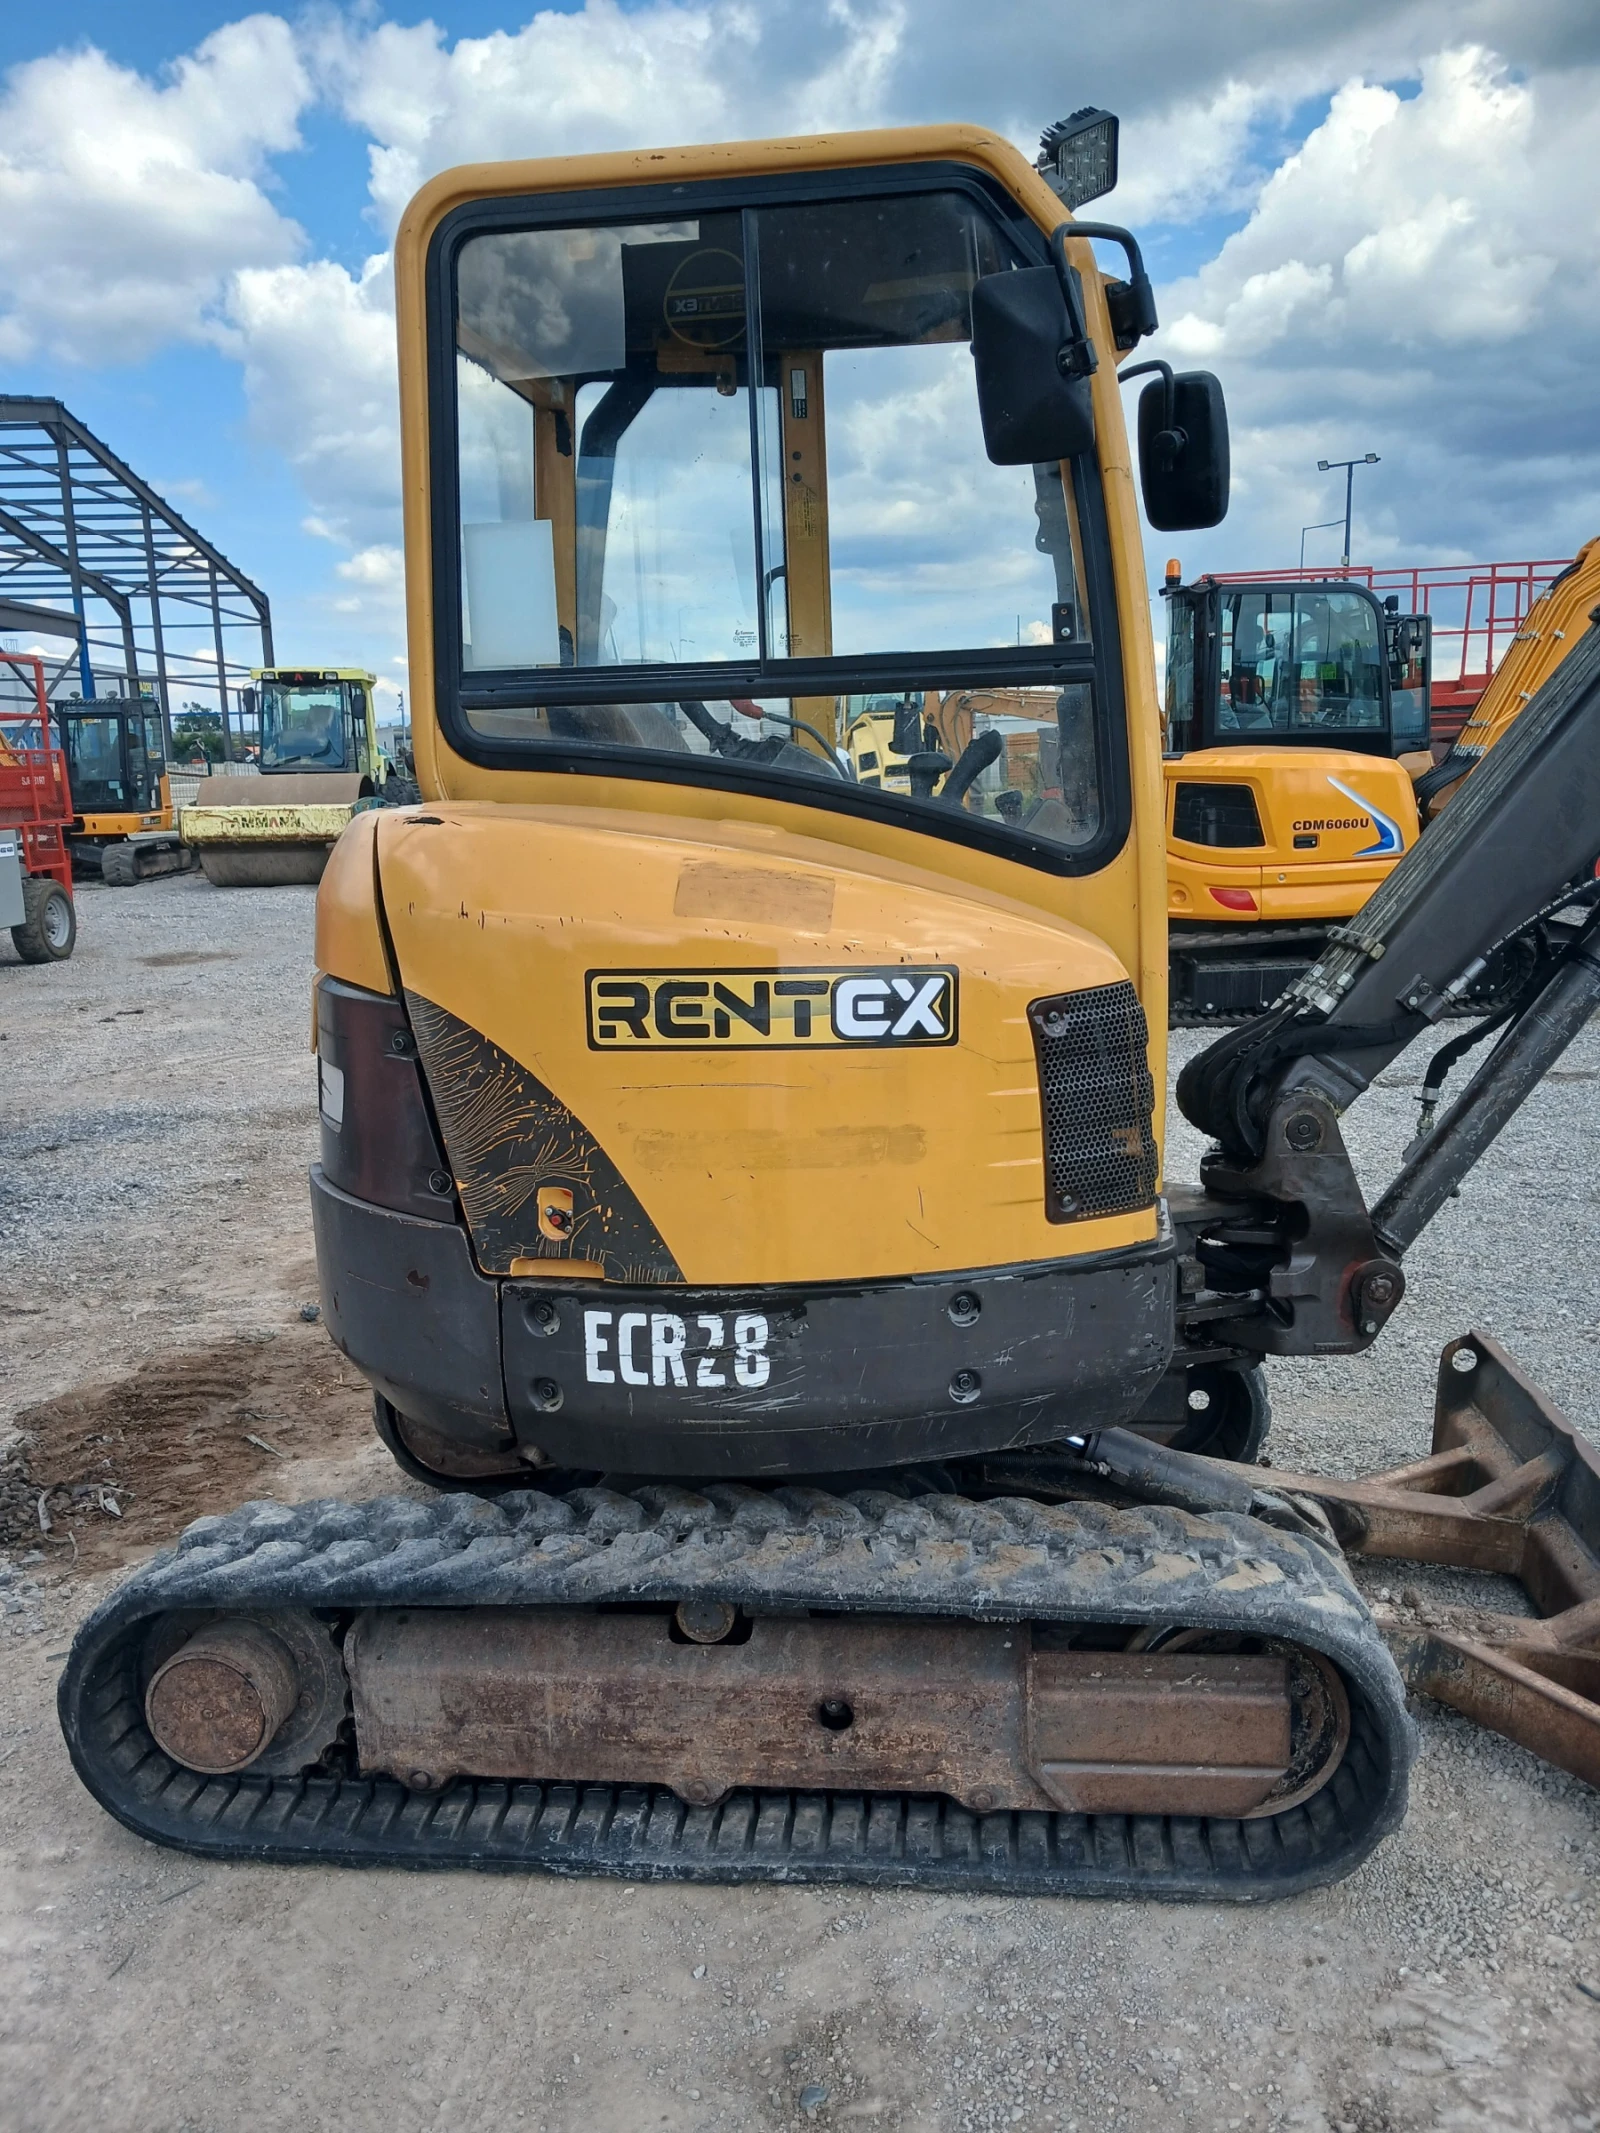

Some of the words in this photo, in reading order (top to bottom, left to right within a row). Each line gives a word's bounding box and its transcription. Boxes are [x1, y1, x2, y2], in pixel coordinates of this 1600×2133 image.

[1292, 818, 1370, 831] CDM6060U
[597, 977, 946, 1038] RENTEX
[584, 1310, 770, 1388] ECR28
